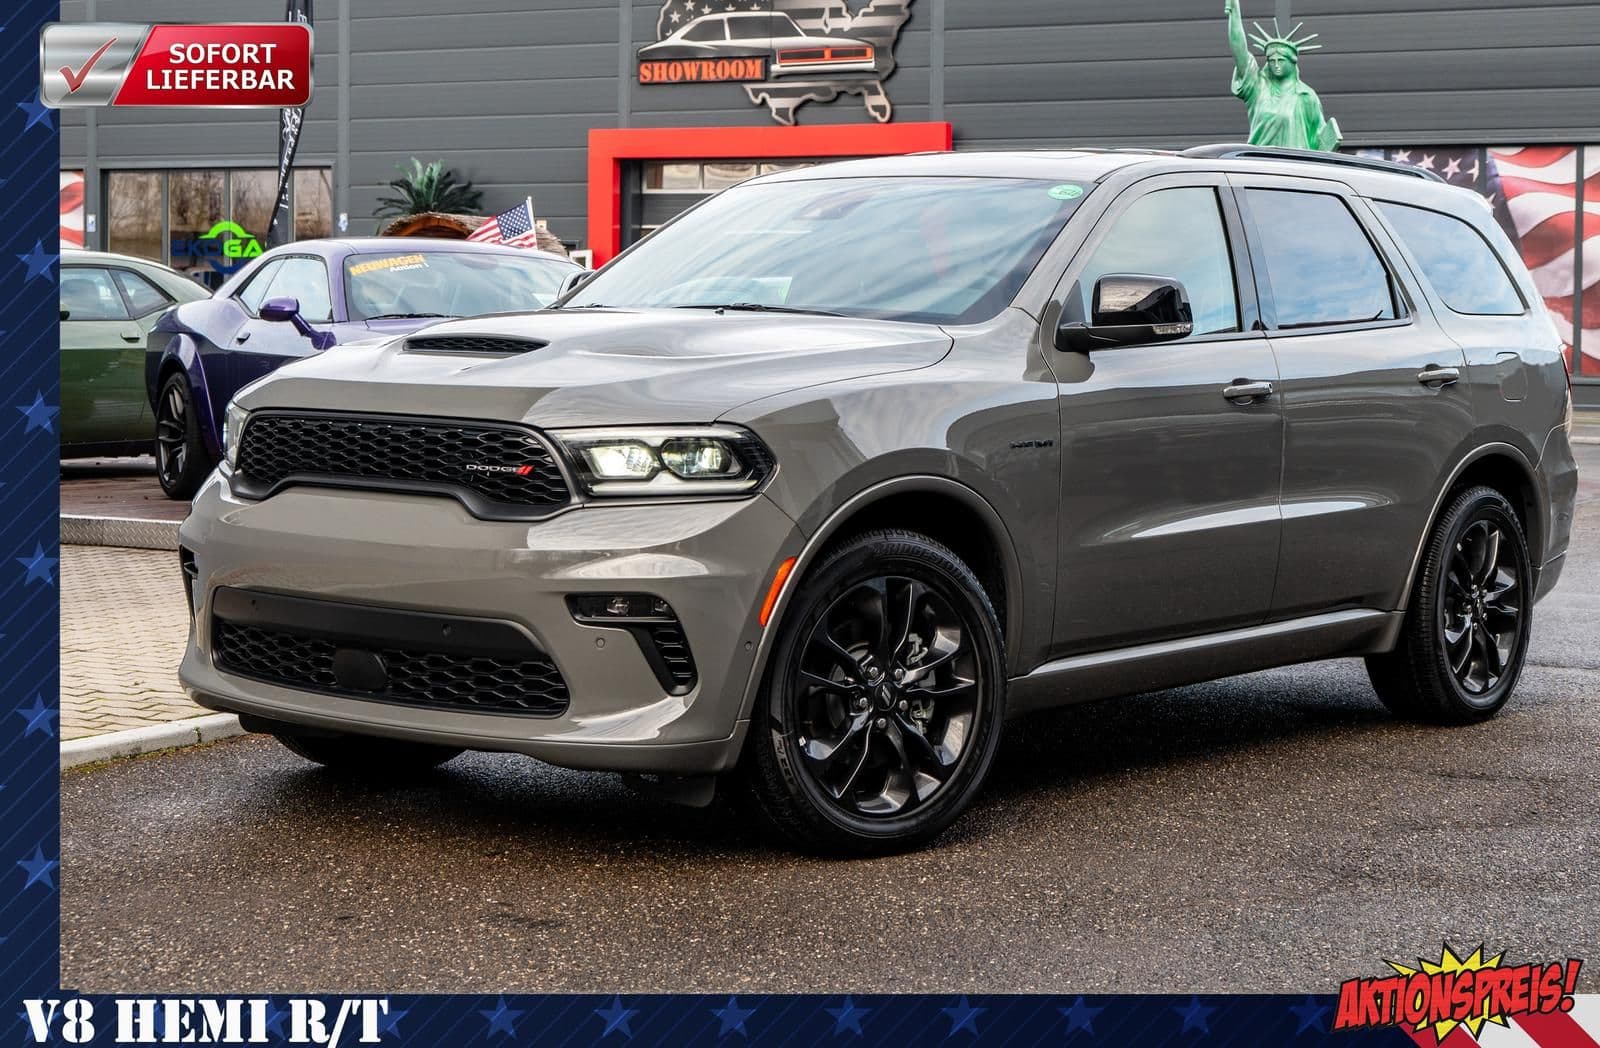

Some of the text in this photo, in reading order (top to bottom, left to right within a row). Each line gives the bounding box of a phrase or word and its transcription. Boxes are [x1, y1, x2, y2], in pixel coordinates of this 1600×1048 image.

[639, 59, 762, 83] SHOWROOM
[172, 239, 267, 258] EKOGA
[466, 464, 518, 473] DODGE
